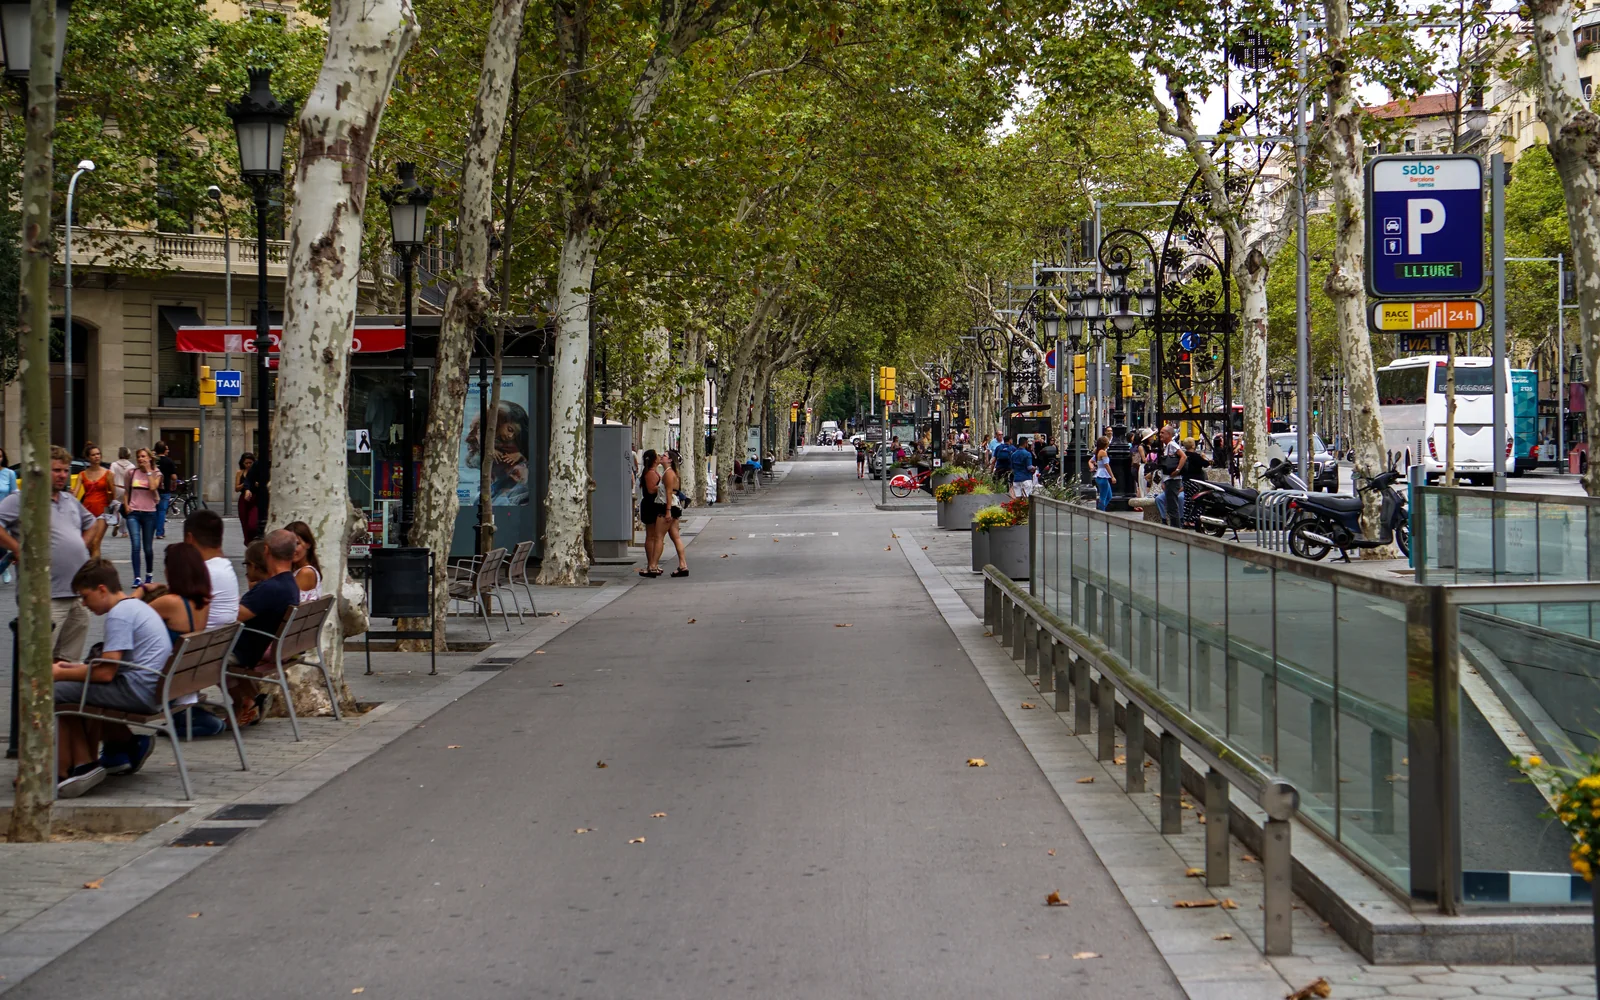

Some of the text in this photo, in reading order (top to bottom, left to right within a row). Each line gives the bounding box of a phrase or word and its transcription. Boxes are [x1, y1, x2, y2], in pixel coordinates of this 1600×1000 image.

[1402, 162, 1435, 175] saba
[1407, 198, 1446, 255] P
[1385, 310, 1409, 318] RACC
[1449, 309, 1474, 321] 24 h
[216, 379, 240, 388] TAXI
